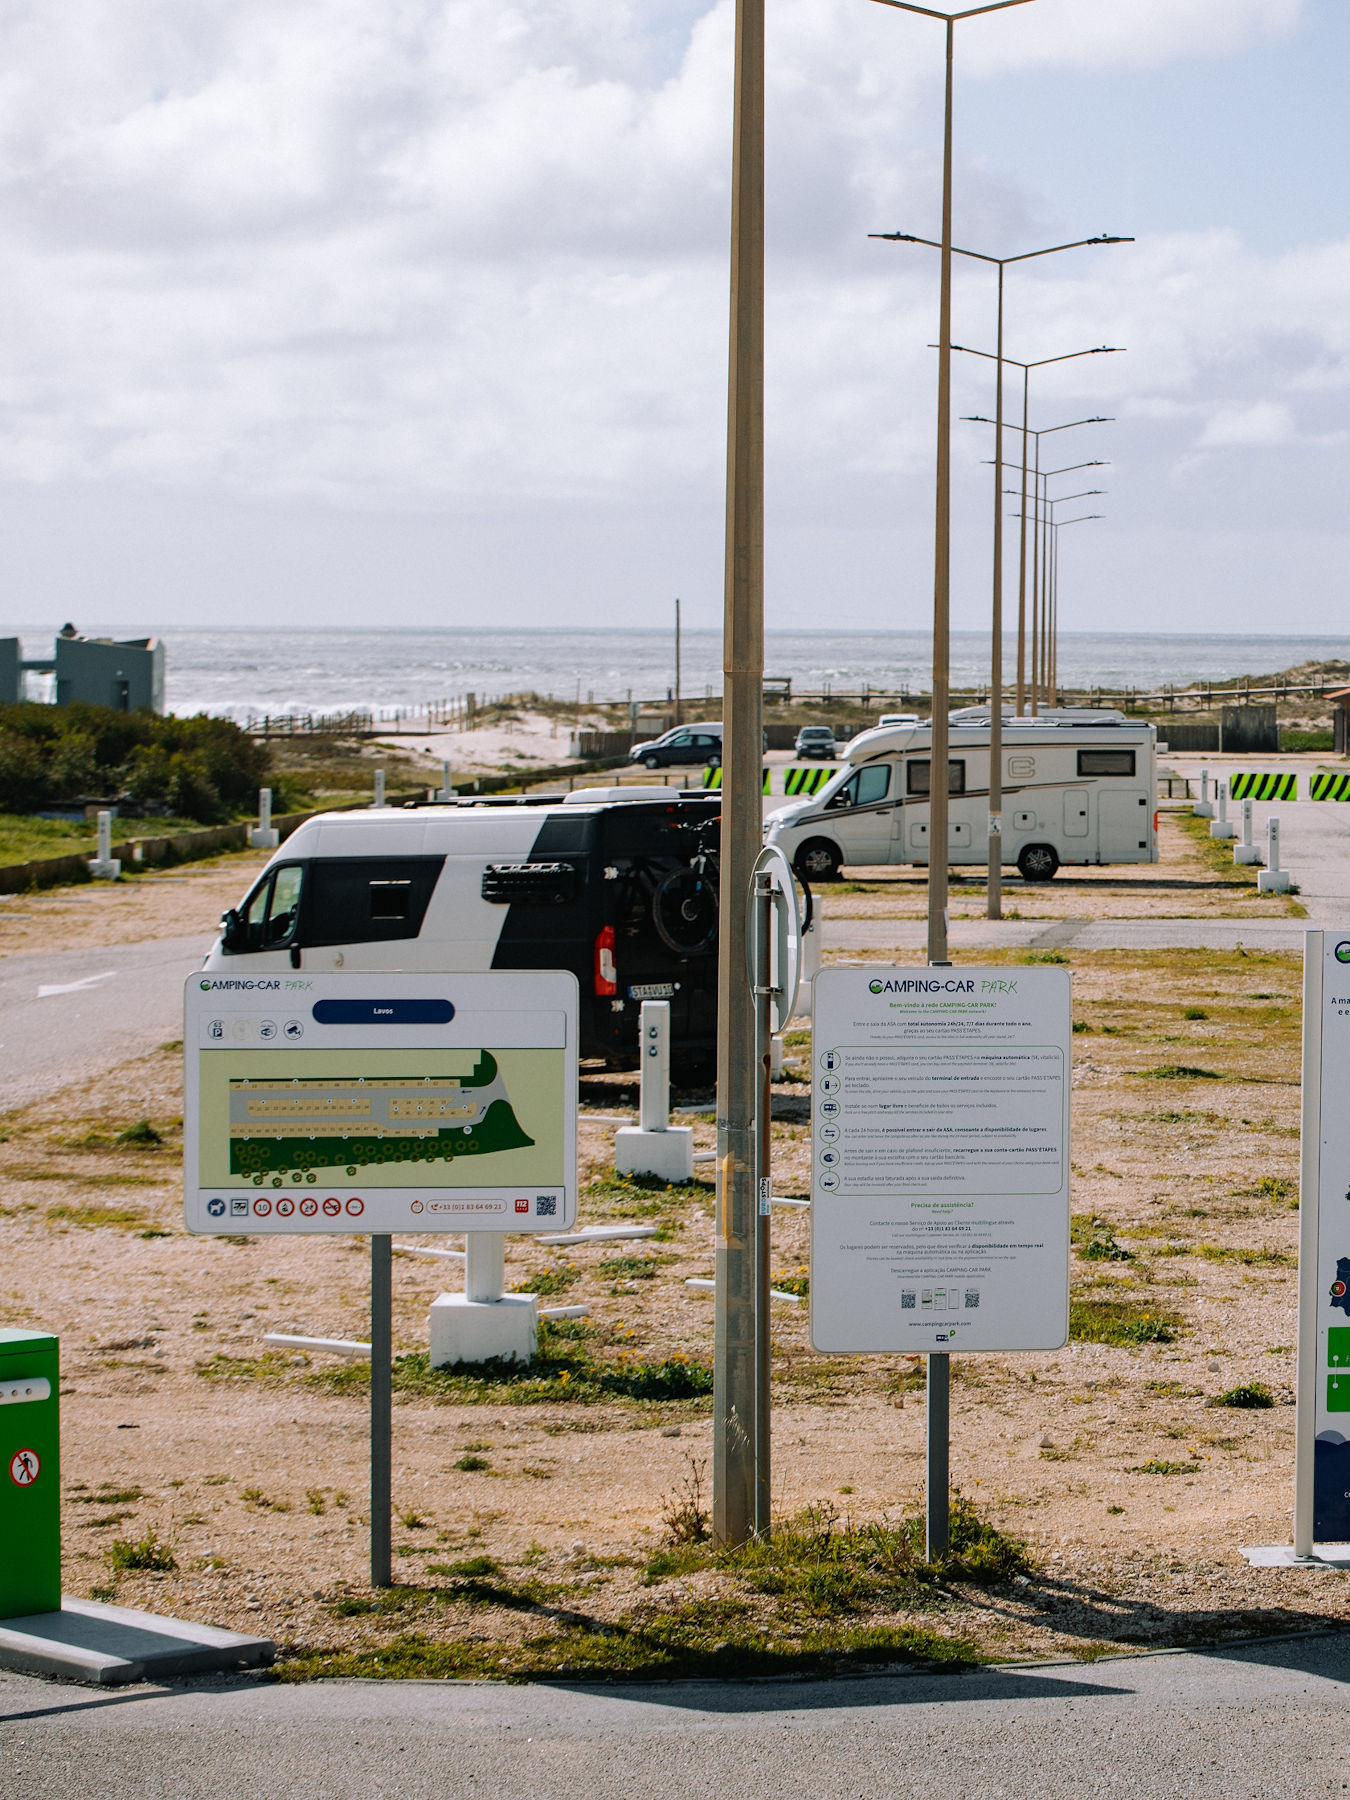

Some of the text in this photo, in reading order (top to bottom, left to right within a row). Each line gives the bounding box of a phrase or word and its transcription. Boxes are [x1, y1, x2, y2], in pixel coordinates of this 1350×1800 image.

[200, 980, 313, 991] CAMPING-CAR PARK
[869, 979, 1018, 994] CAMPING-CAR PARK
[1331, 997, 1337, 1005] A
[373, 1007, 394, 1015] Lavos
